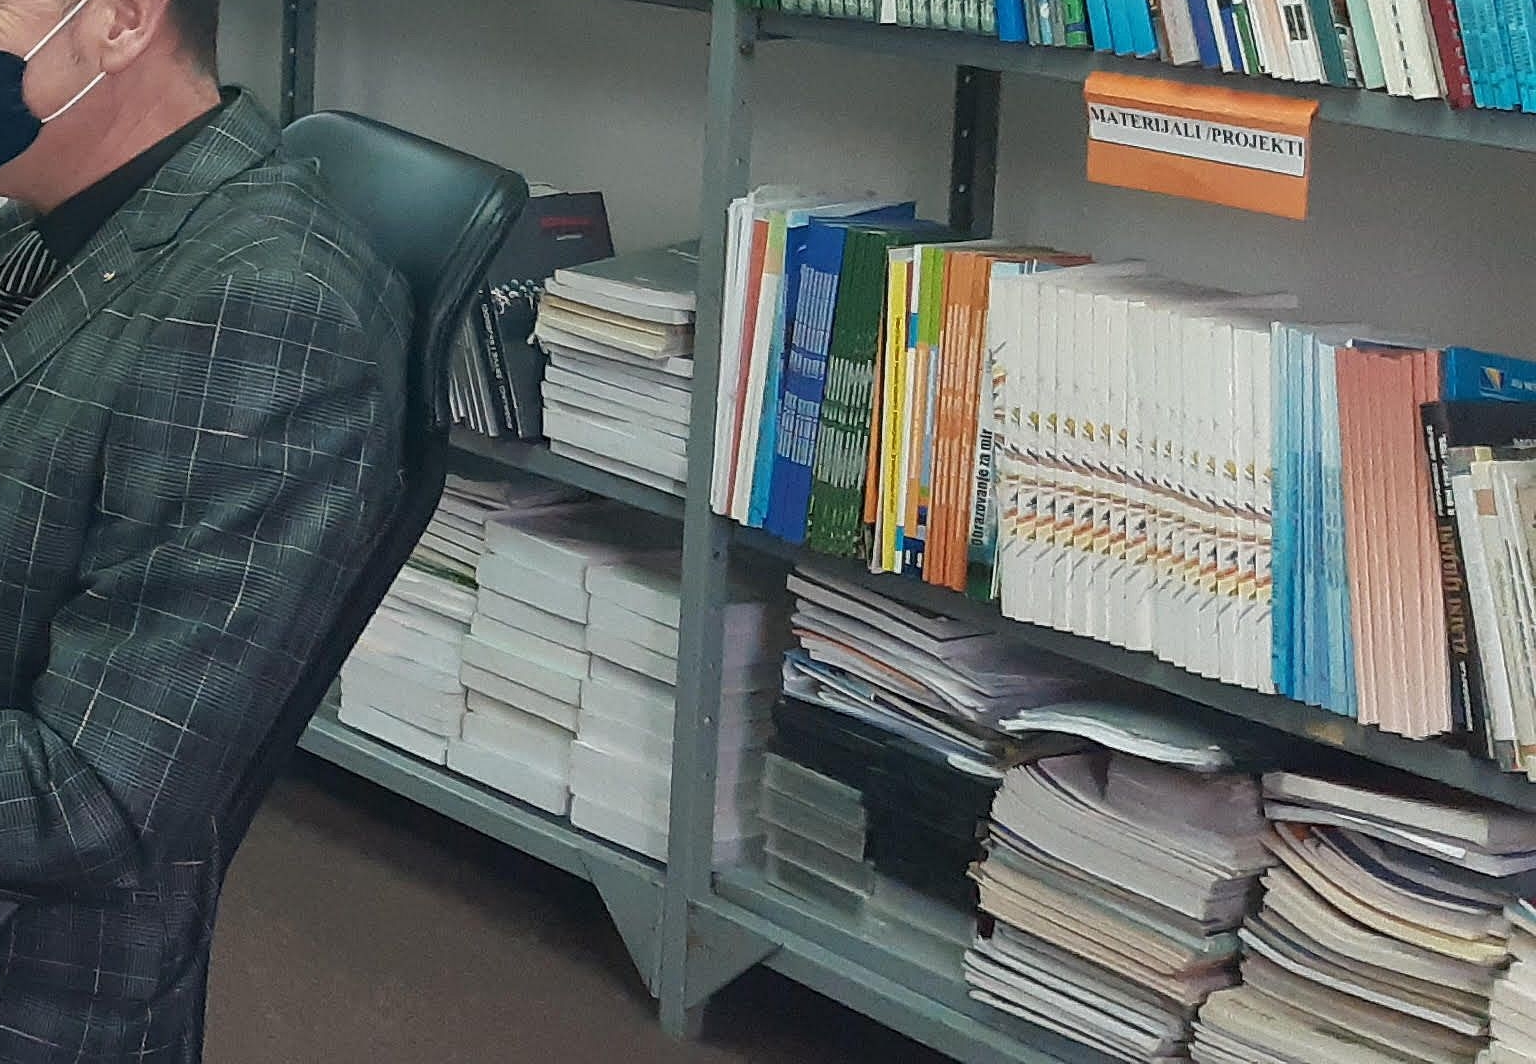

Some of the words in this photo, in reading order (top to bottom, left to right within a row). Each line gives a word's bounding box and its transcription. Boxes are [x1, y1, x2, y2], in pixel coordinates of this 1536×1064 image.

[1090, 105, 1201, 140] MATERIJALI
[1206, 126, 1304, 158] /PROJEKTI
[979, 428, 993, 451] mir
[978, 453, 991, 468] za
[971, 469, 992, 547] Obrazovanje
